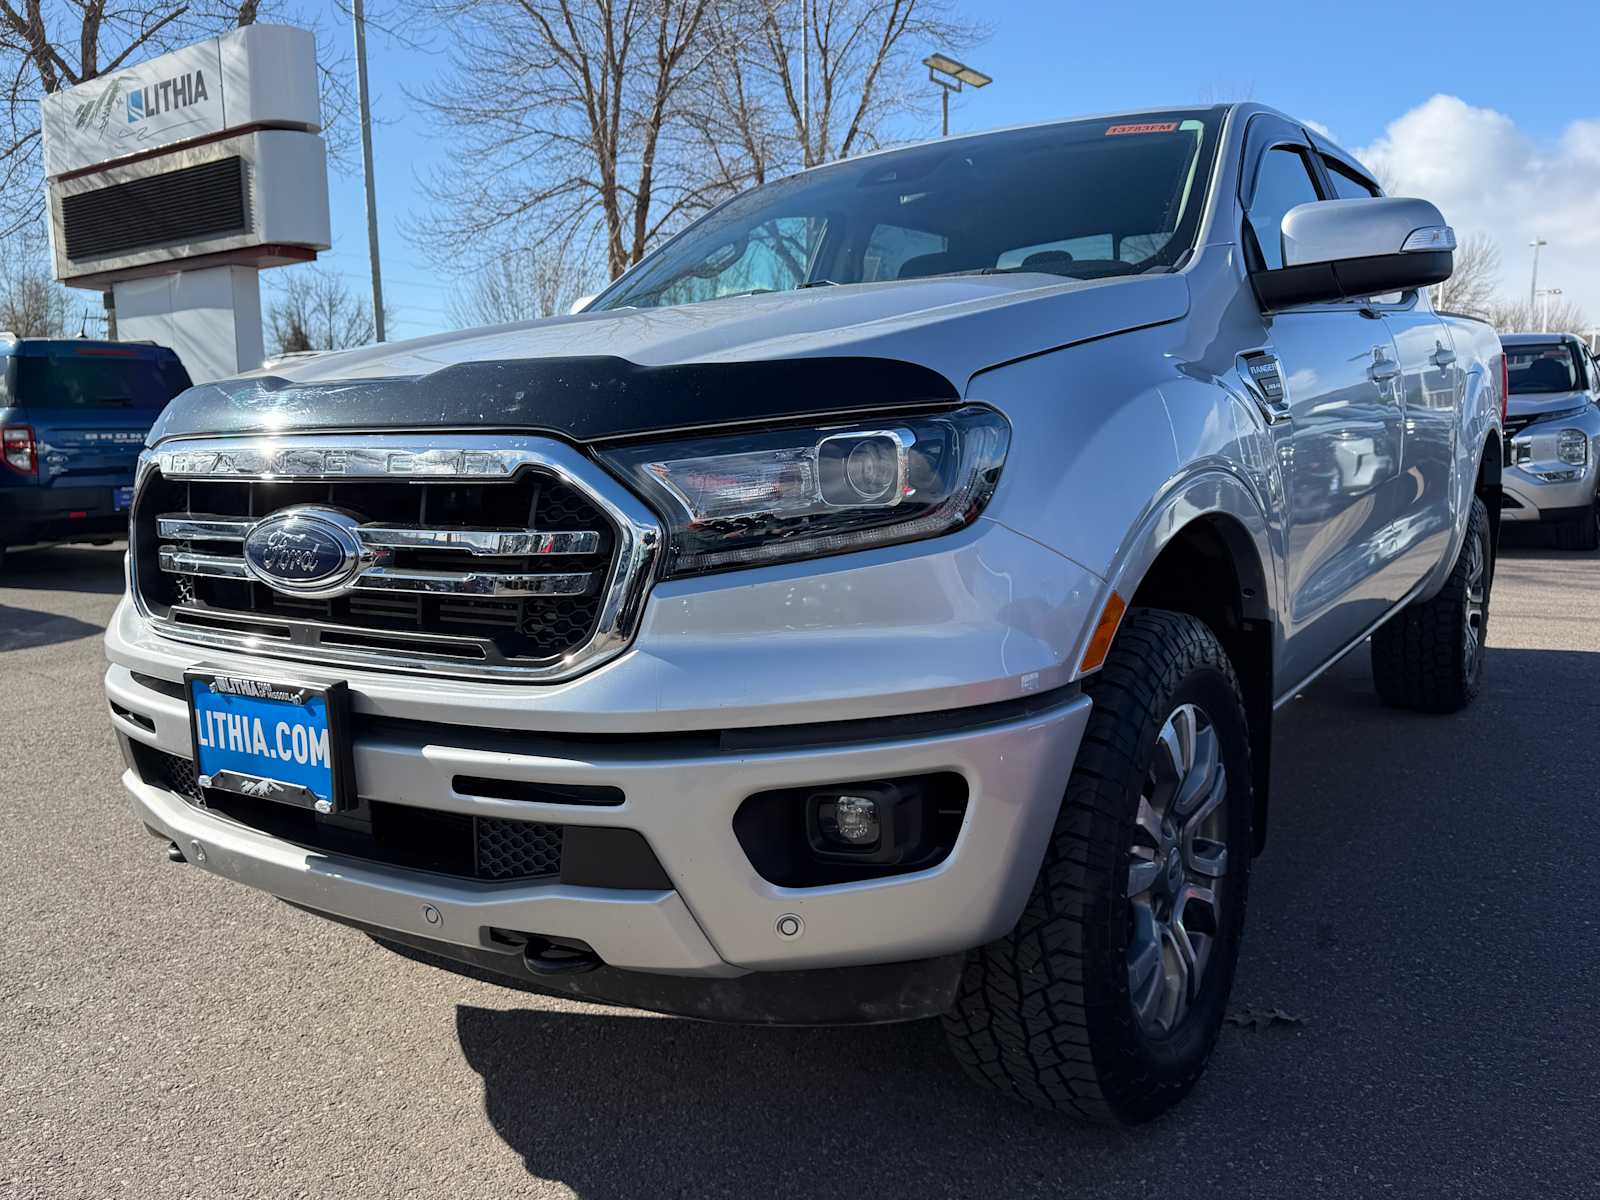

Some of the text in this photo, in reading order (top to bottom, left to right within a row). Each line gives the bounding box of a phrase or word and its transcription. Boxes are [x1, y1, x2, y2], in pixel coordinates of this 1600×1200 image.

[144, 70, 209, 118] LITHIA
[167, 450, 510, 475] RANGER
[263, 530, 320, 572] Ford
[224, 677, 260, 697] LITHIA
[195, 709, 331, 769] LITHIA.COM
